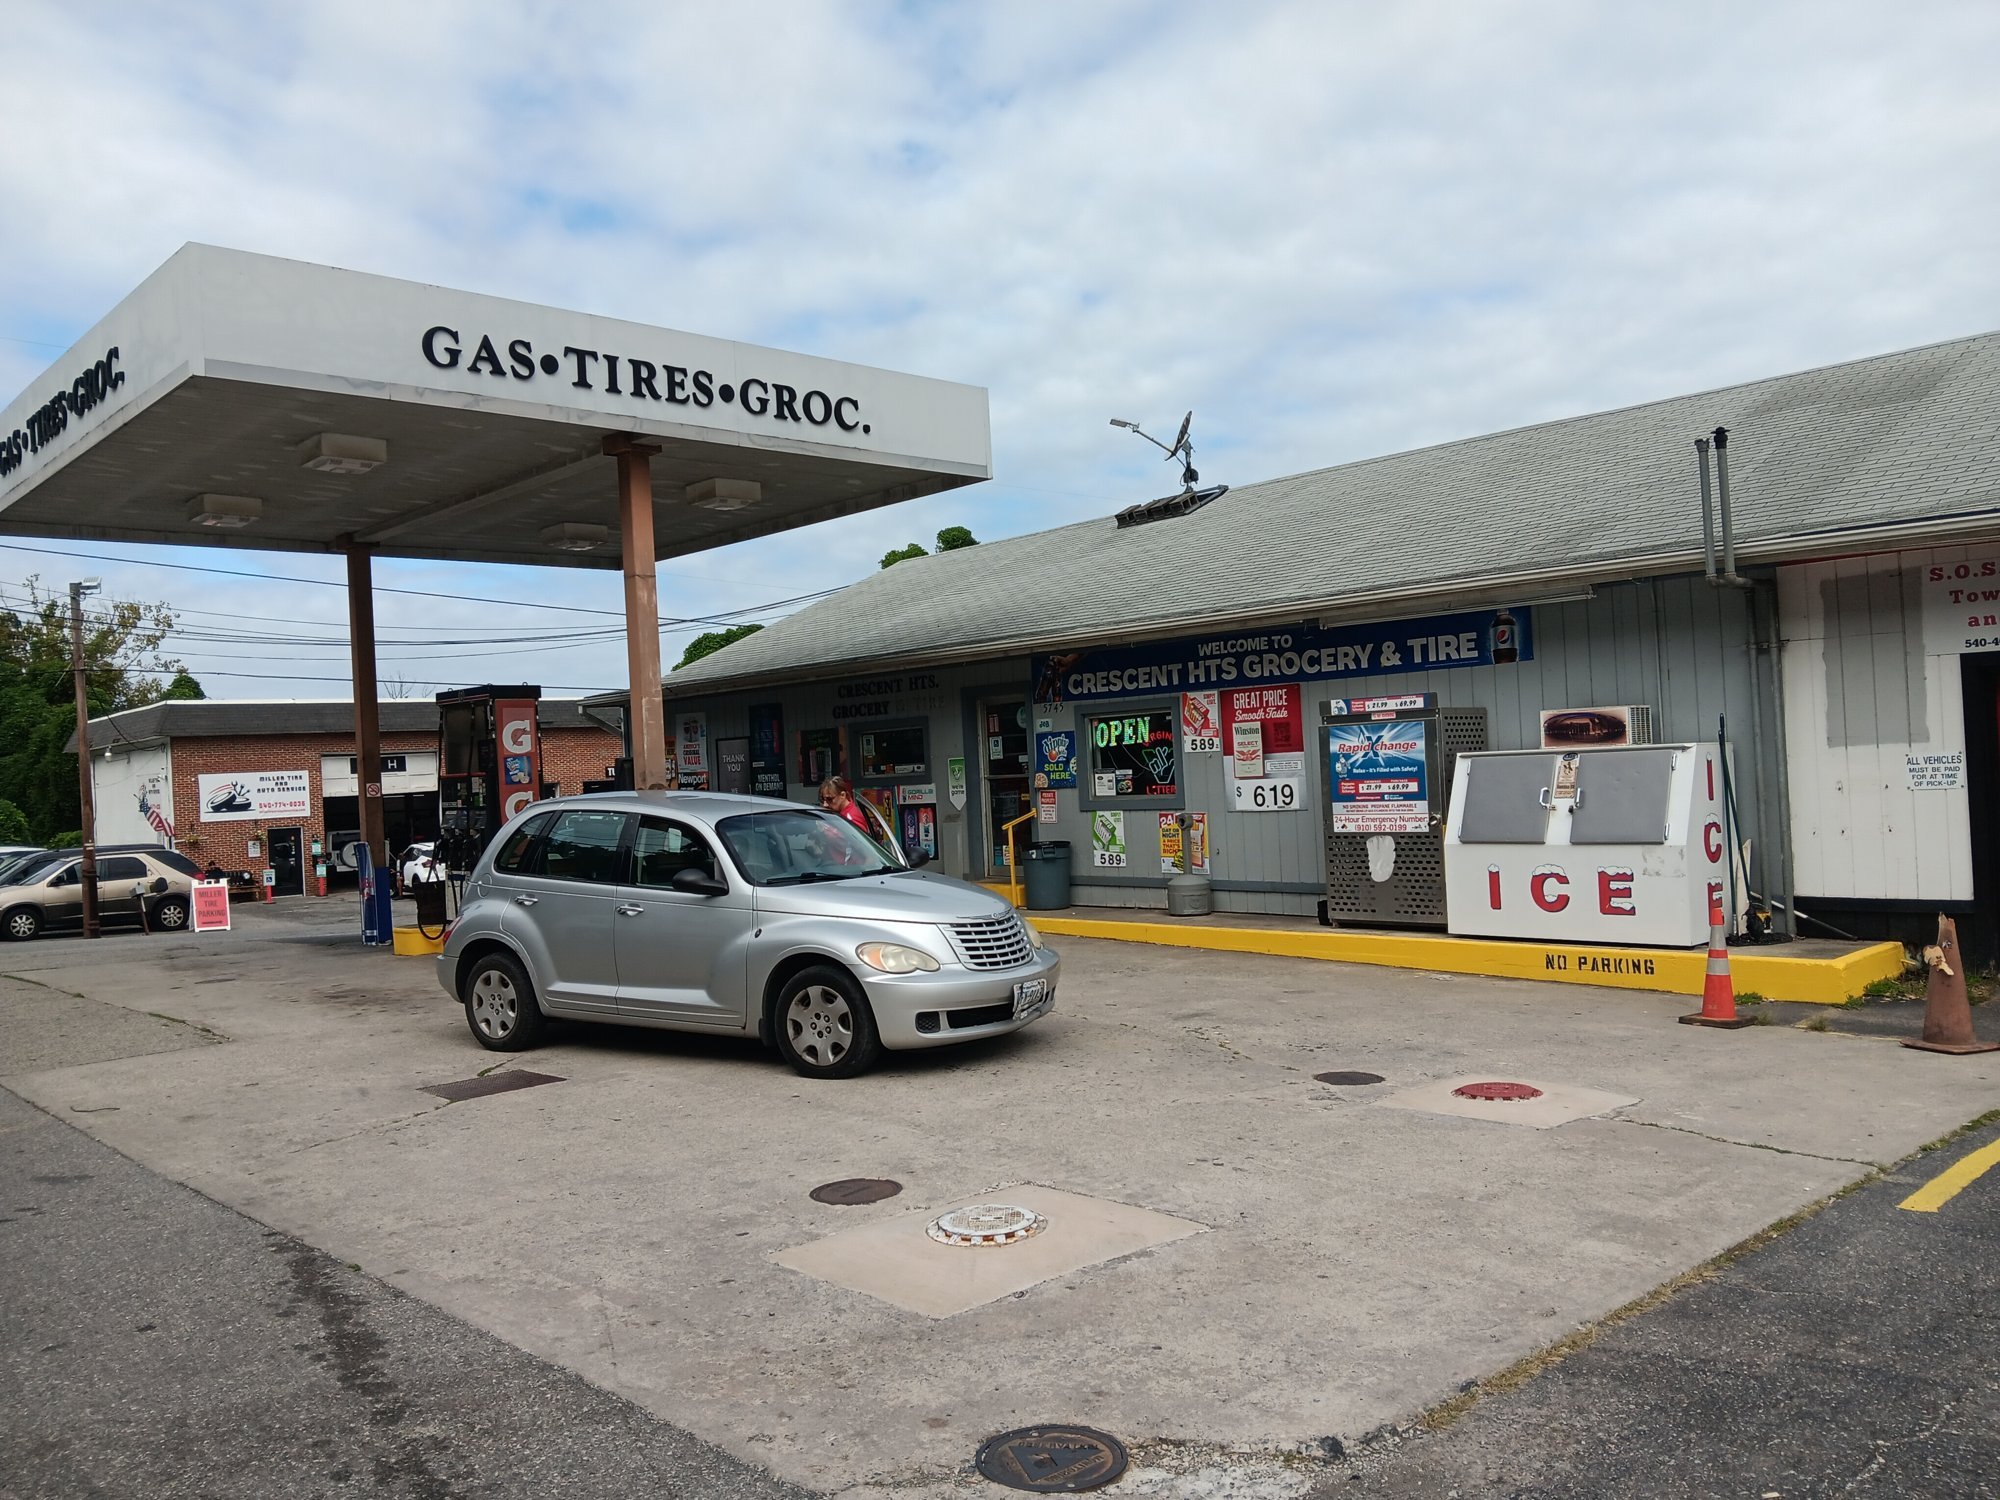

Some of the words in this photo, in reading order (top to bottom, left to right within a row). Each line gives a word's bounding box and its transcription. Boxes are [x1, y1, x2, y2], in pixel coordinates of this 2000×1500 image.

[1198, 637, 1269, 657] WELCOME
[1271, 635, 1292, 649] TO
[1965, 637, 2000, 648] 540-4
[1067, 663, 1182, 694] CRESCENT
[1188, 656, 1238, 684] HTS
[1242, 642, 1374, 678] GROCERY
[1380, 641, 1402, 667] &
[1407, 631, 1479, 663] TIRE
[838, 680, 903, 699] CRESCENT
[909, 674, 939, 692] HTS.
[1233, 691, 1260, 710] GREAT
[1262, 689, 1288, 706] PRICE
[832, 700, 890, 720] GROCERY
[1044, 703, 1064, 713] 5745
[1234, 708, 1264, 721] Smooth
[1266, 706, 1288, 718] Taste
[1096, 717, 1150, 747] OPEN
[1234, 726, 1260, 735] Winston
[683, 756, 701, 766] VALUE
[722, 754, 744, 763] THANK
[1906, 757, 1920, 765] ALL
[1923, 755, 1962, 765] VEHICLES
[1044, 763, 1064, 771] SOLD
[678, 774, 706, 784] Newport
[758, 774, 780, 782] MENTHOL
[1050, 771, 1072, 780] HERE
[756, 783, 762, 791] ON
[764, 782, 784, 791] DEMAND
[1236, 786, 1242, 797] $
[1362, 816, 1397, 824] Emergency
[1488, 863, 1636, 916] ICE
[1545, 952, 1567, 971] NO
[1578, 956, 1655, 976] PARKING
